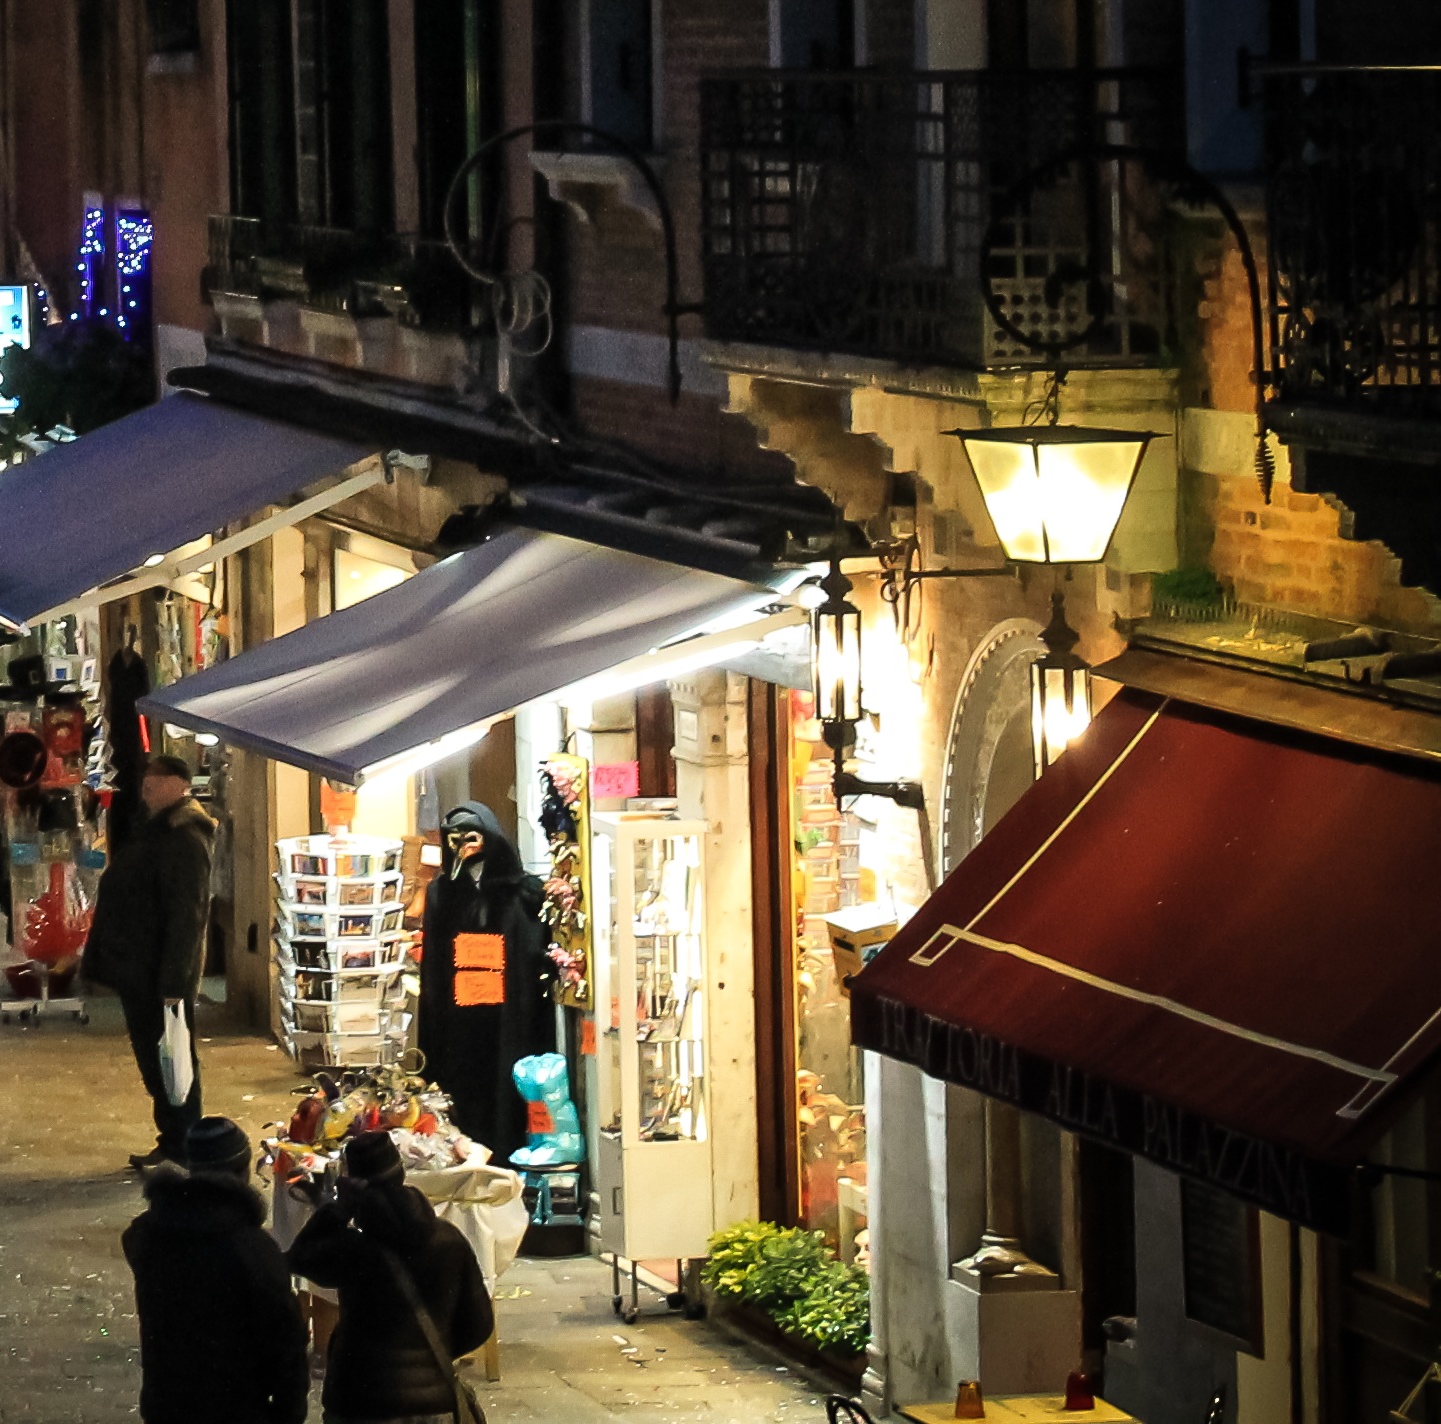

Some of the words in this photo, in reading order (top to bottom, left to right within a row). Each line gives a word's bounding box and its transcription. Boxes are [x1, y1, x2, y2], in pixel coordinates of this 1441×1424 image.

[877, 996, 1022, 1100] TRATTORIA
[1047, 1066, 1119, 1136] ALLA
[1143, 1098, 1313, 1218] PALAZZINA
